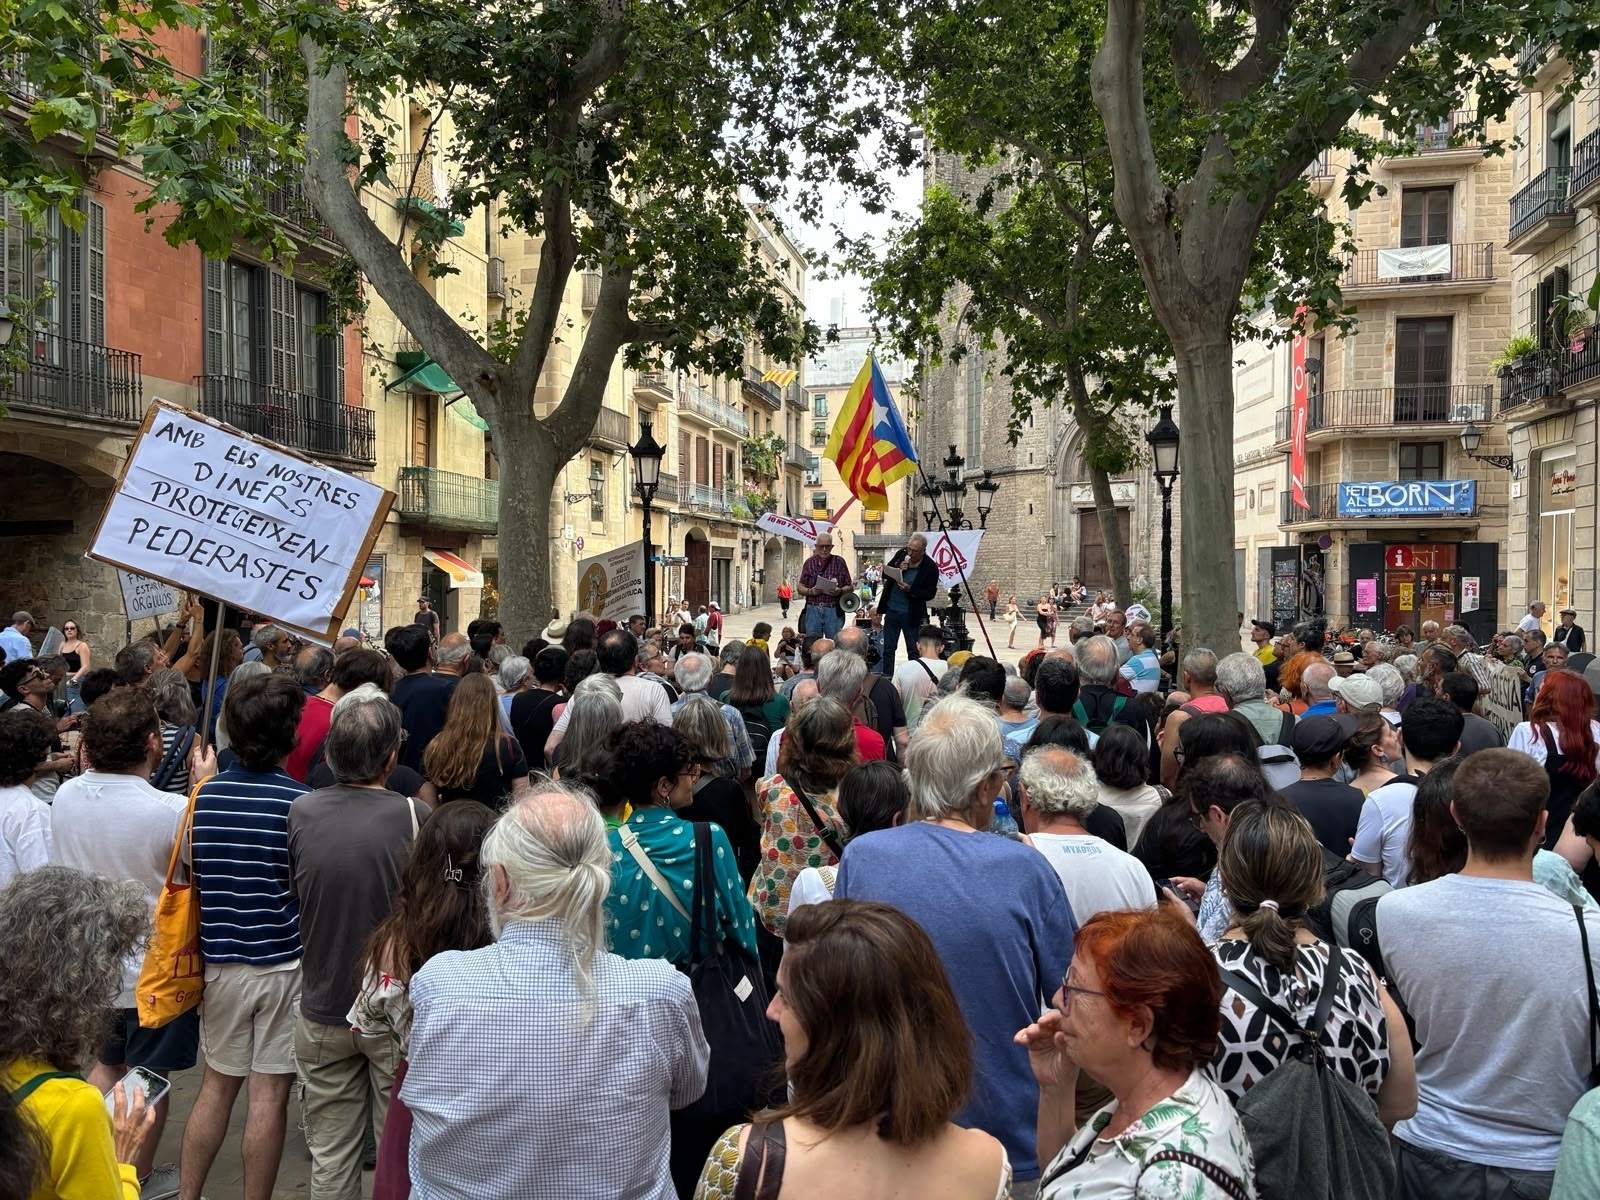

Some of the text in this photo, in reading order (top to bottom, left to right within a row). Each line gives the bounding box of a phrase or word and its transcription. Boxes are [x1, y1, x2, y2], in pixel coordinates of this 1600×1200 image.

[155, 421, 361, 510] AMB ELS NOSTRES
[193, 462, 313, 518] DINERS
[1368, 483, 1455, 507] BORN
[151, 481, 329, 563] PROTEGEIXEN
[1345, 498, 1367, 507] AL
[127, 517, 323, 600] PEDERASTES
